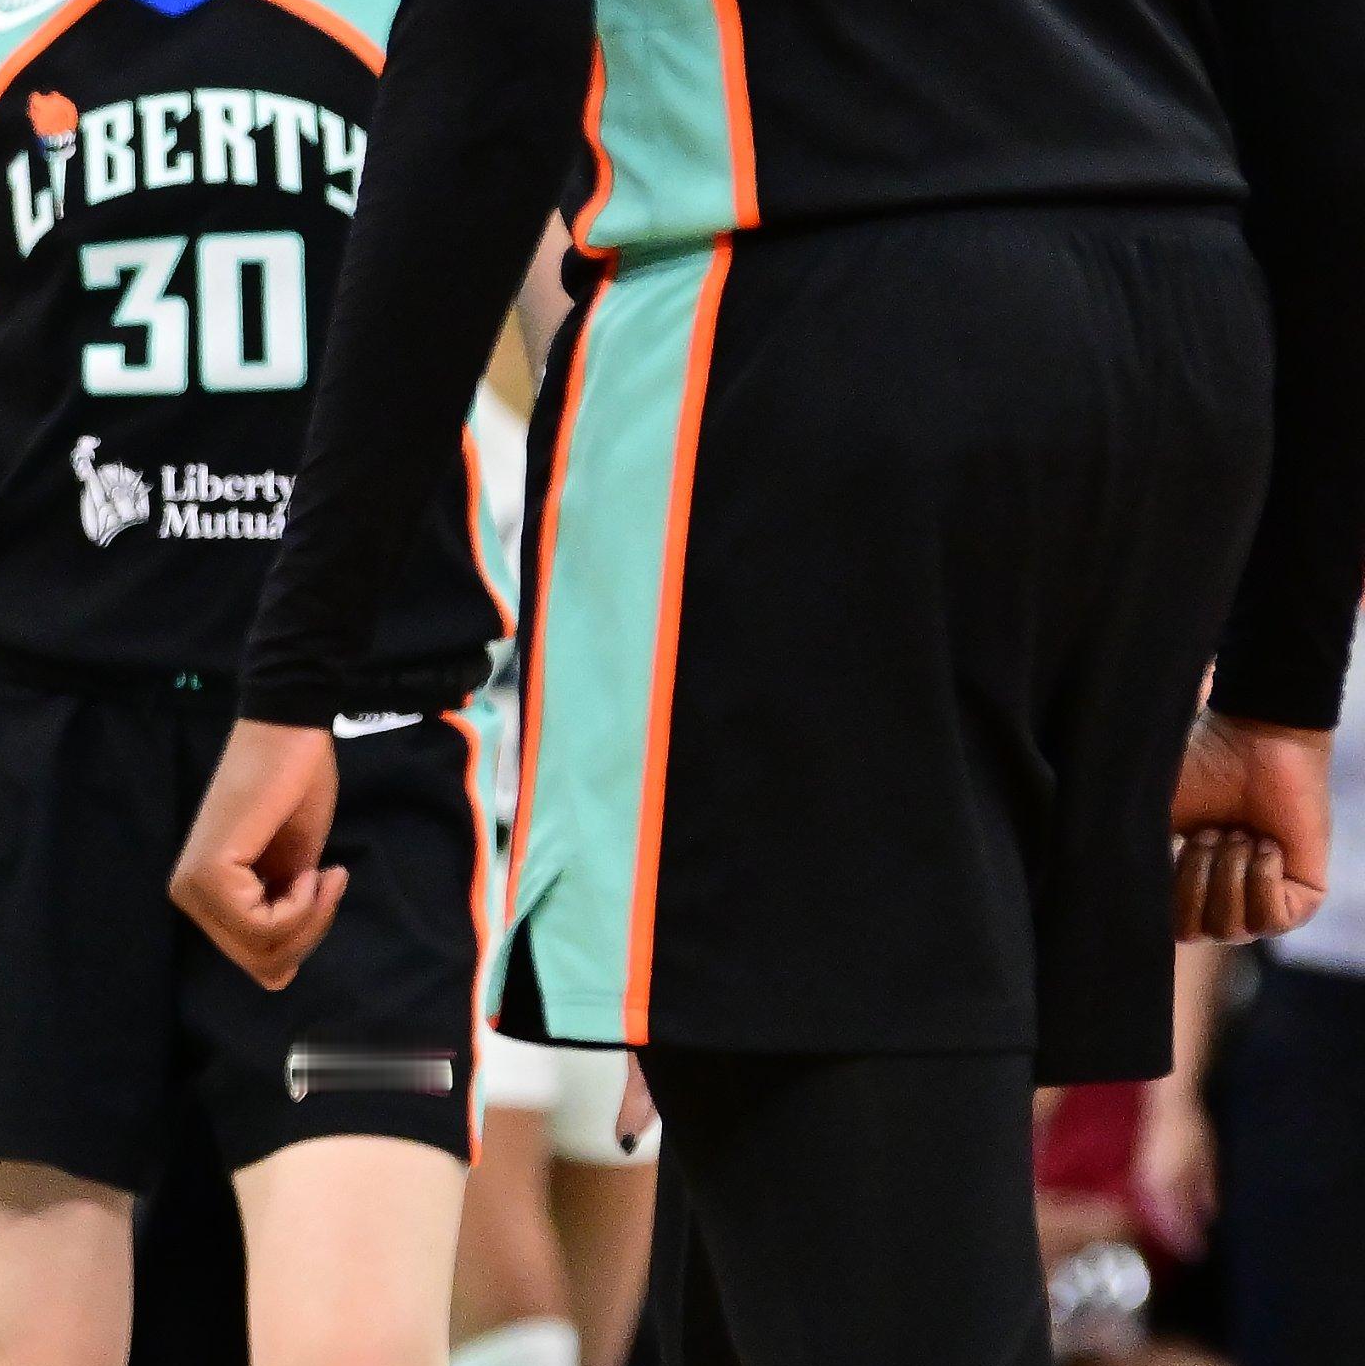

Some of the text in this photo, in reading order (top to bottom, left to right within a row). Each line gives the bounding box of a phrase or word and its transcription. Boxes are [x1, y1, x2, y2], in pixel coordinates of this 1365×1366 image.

[6, 87, 368, 260] LIBERTY
[77, 229, 309, 398] 30
[158, 501, 286, 540] Mutua
[161, 462, 297, 513] Liberty
